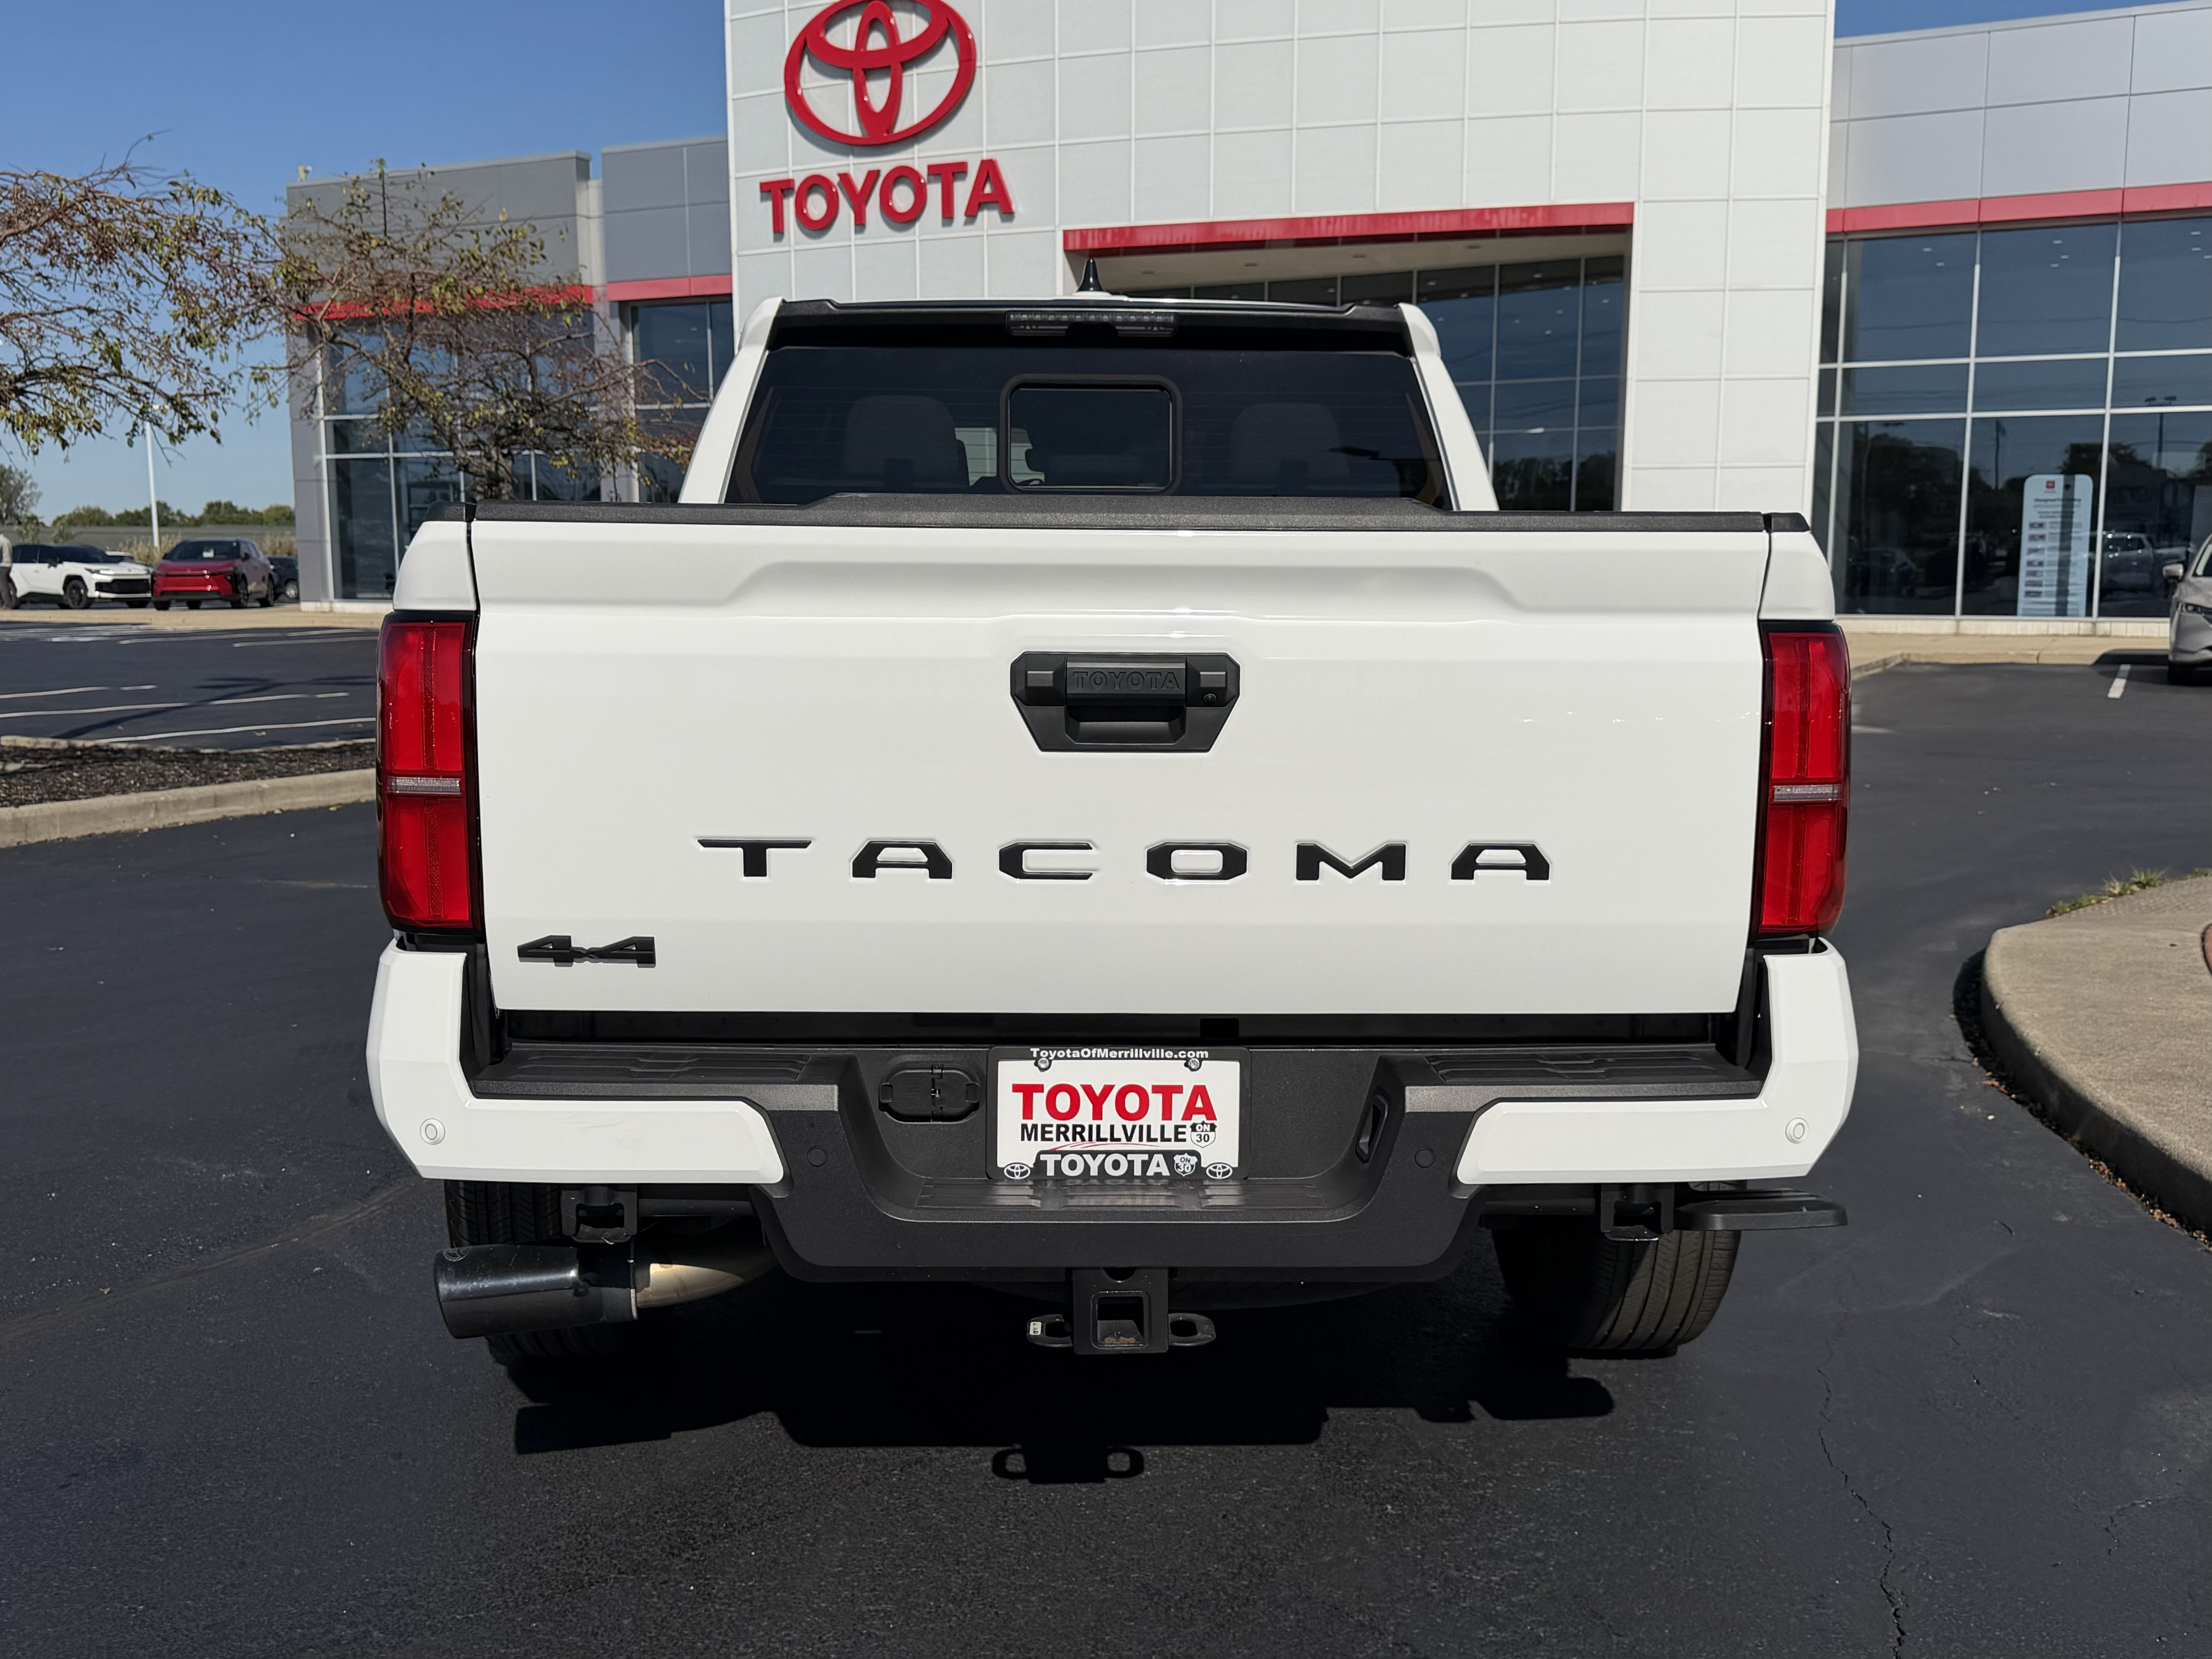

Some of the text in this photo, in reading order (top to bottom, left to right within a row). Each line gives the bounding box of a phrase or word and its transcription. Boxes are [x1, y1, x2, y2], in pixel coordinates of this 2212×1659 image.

[760, 159, 1014, 234] TOYOTA
[1073, 672, 1180, 690] TOYOTA
[697, 839, 1550, 880] TACOMA
[1031, 1048, 1209, 1059] ToyotaOfMerrillville.com
[1012, 1084, 1217, 1121] TOYOTA
[1021, 1124, 1186, 1142] MERRILLVILLE
[1196, 1134, 1209, 1142] 30
[1040, 1154, 1170, 1176] TOYOTA
[1178, 1164, 1191, 1172] 30
